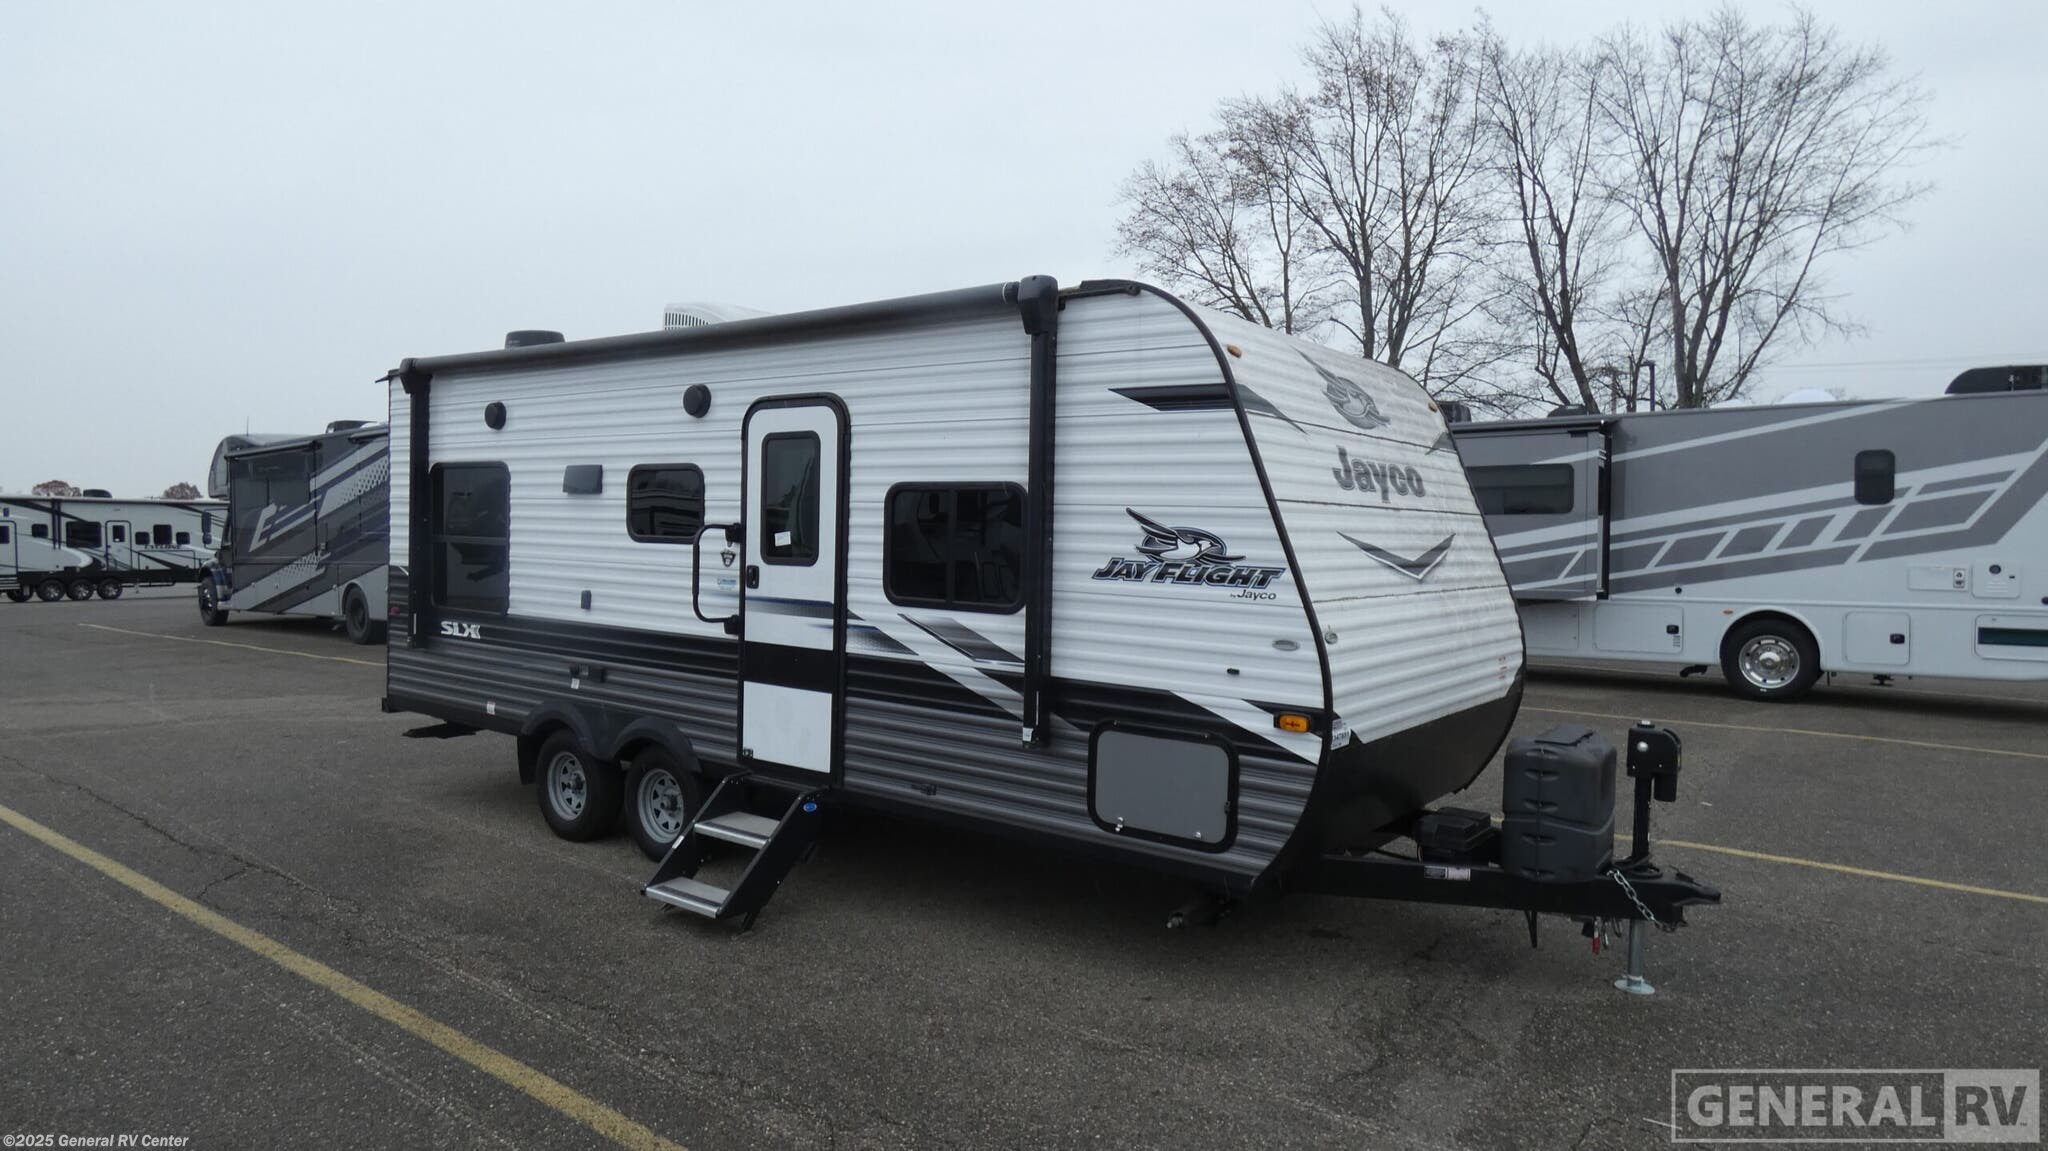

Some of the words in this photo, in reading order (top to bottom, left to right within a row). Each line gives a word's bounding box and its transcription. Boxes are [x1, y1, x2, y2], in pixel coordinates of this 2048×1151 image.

[1332, 445, 1426, 504] Jayco
[1092, 557, 1159, 583] JAY
[1151, 561, 1287, 590] FLIGHT
[1237, 589, 1277, 601] Jayco
[440, 620, 481, 640] SLX
